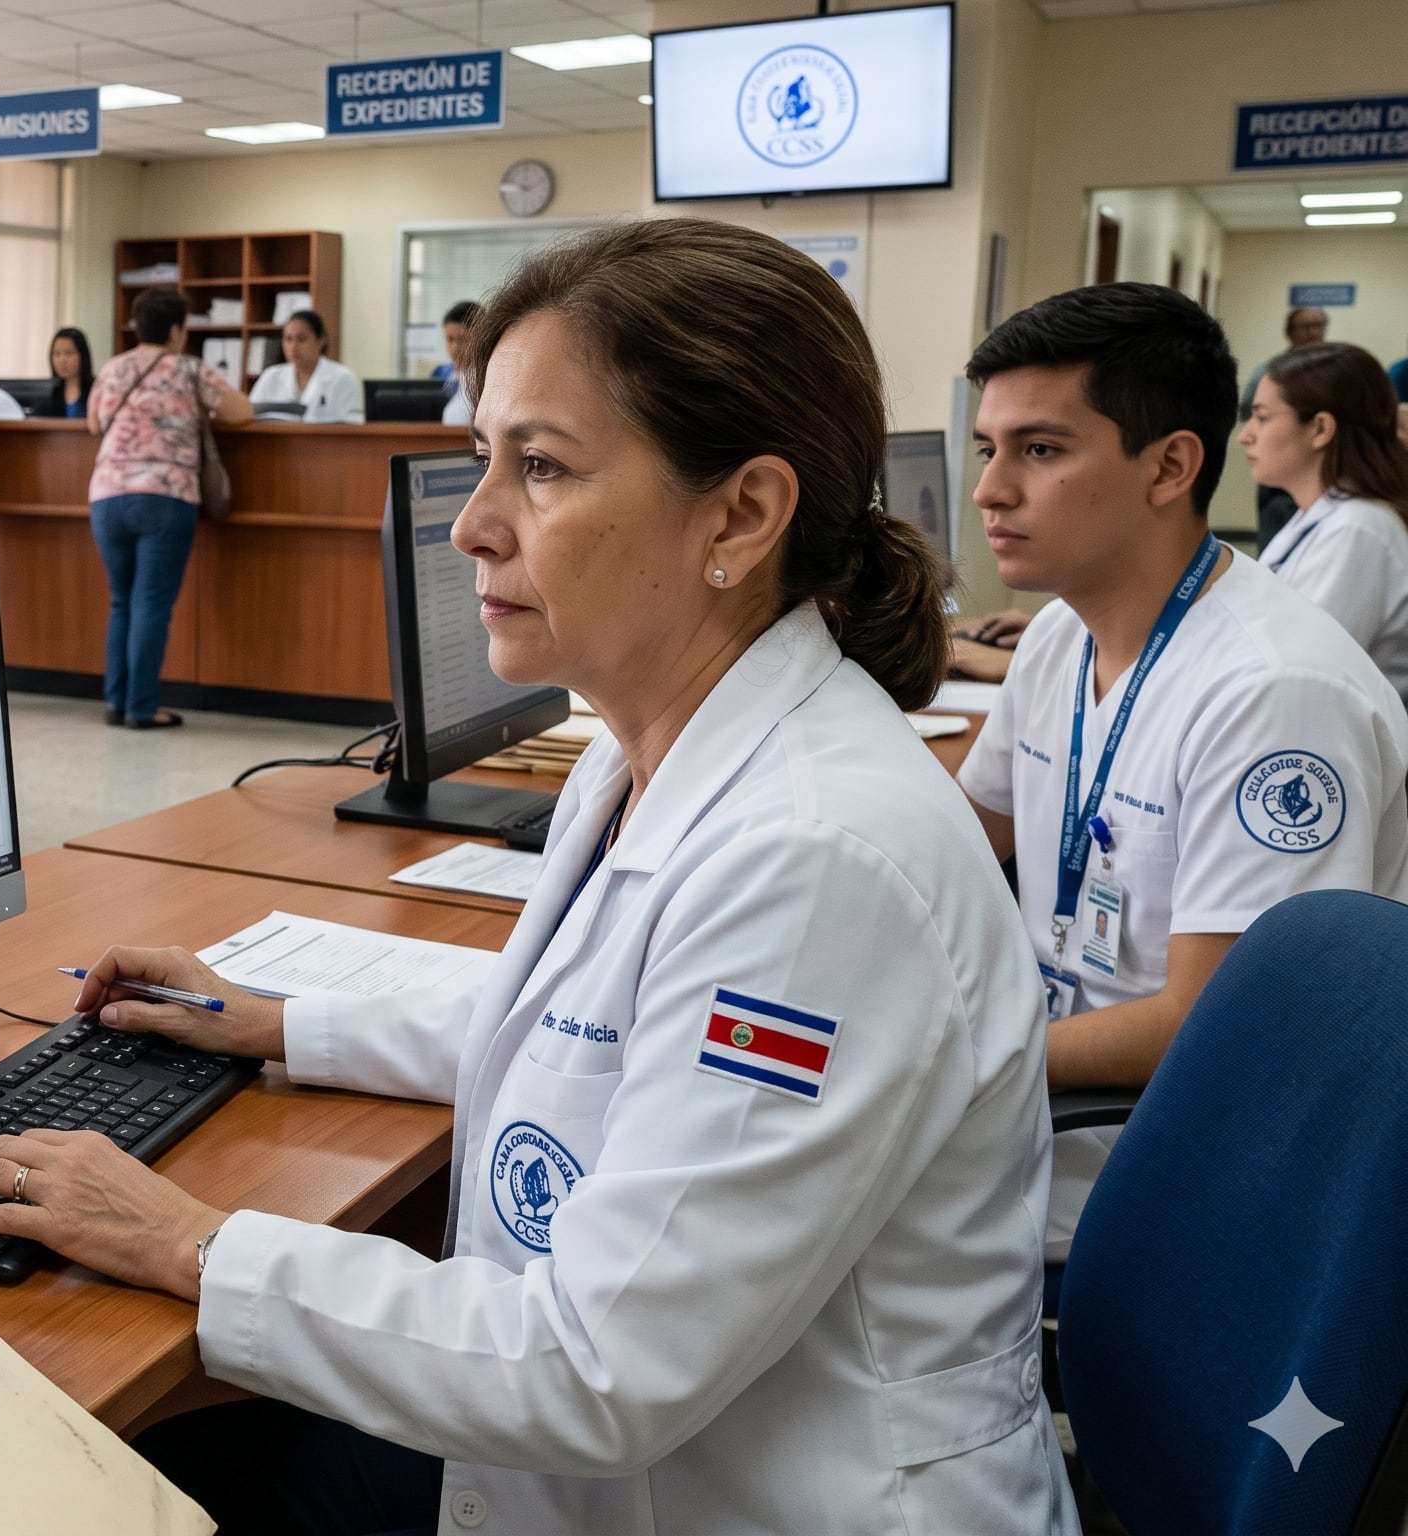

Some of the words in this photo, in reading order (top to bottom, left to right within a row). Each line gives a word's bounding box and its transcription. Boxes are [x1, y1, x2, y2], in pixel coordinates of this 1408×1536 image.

[336, 61, 458, 97] RECEPCIÓN
[462, 61, 491, 88] DE
[341, 92, 485, 126] EXPEDIENTES
[1249, 102, 1382, 136] RECEPCIÓN
[1387, 105, 1408, 128] D
[1268, 828, 1320, 847] CCSS
